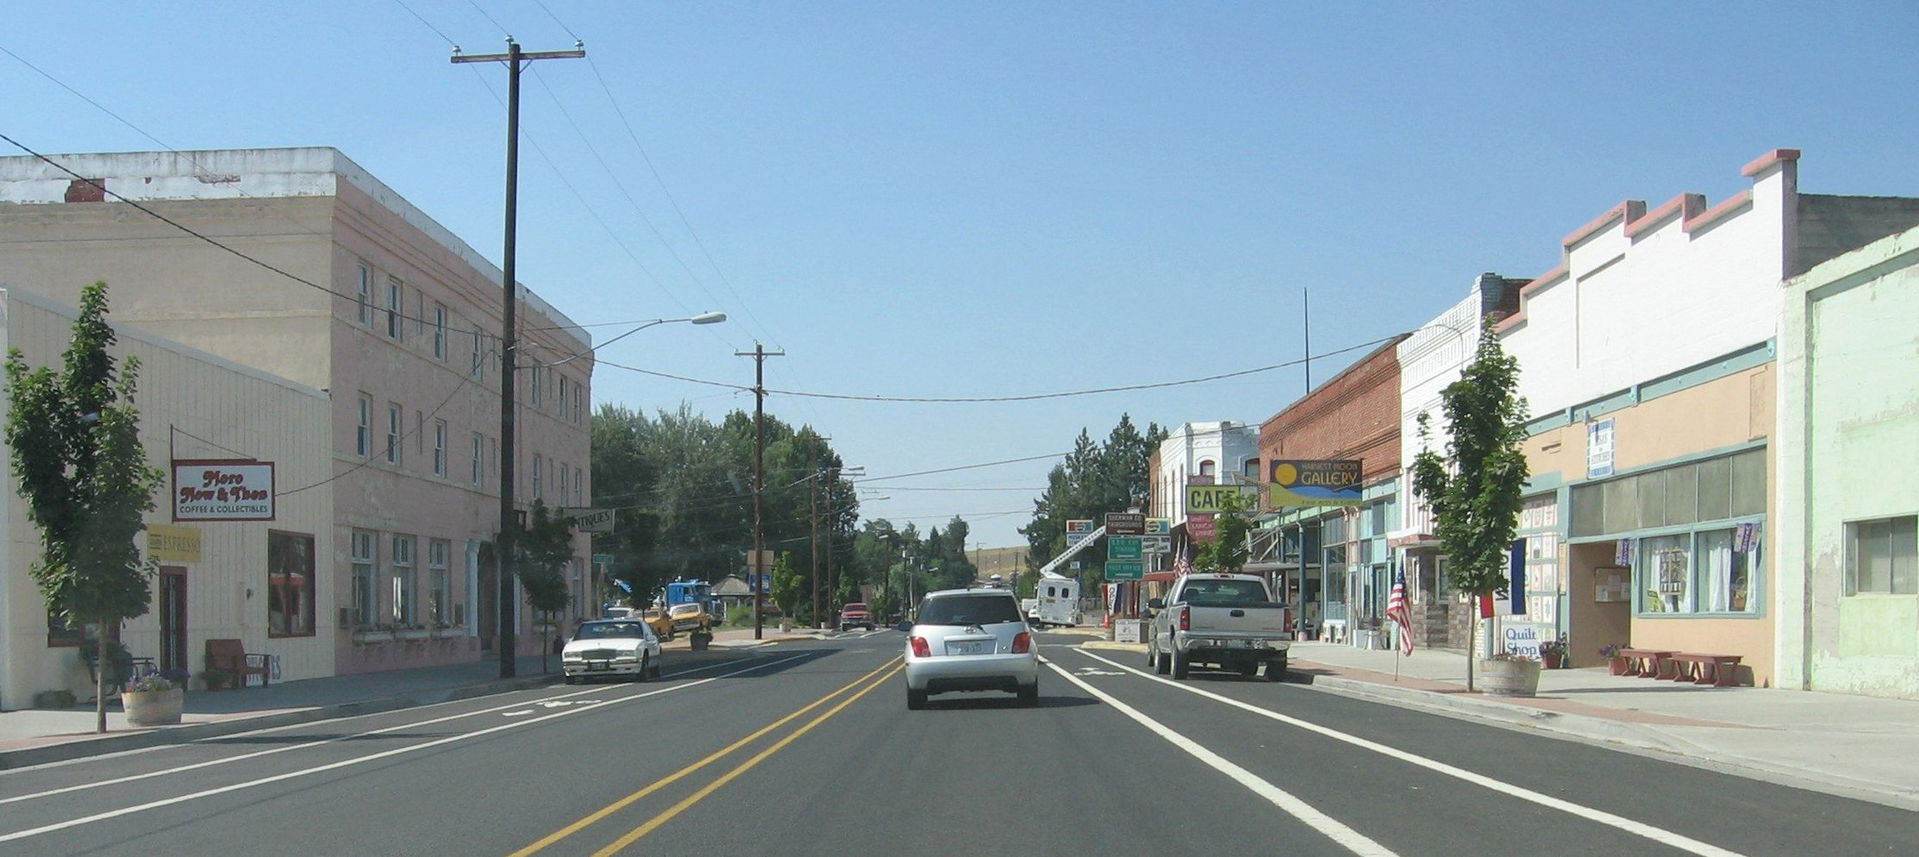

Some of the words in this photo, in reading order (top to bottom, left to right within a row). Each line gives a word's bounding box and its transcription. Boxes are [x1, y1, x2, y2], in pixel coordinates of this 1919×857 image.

[203, 471, 243, 487] Moro
[1302, 472, 1358, 485] GALLERY
[180, 487, 215, 503] Now
[217, 488, 228, 502] &
[231, 486, 268, 502] Then
[164, 536, 201, 552] ESPRESSO
[1506, 628, 1537, 640] Quilt
[1507, 643, 1537, 658] Shop
